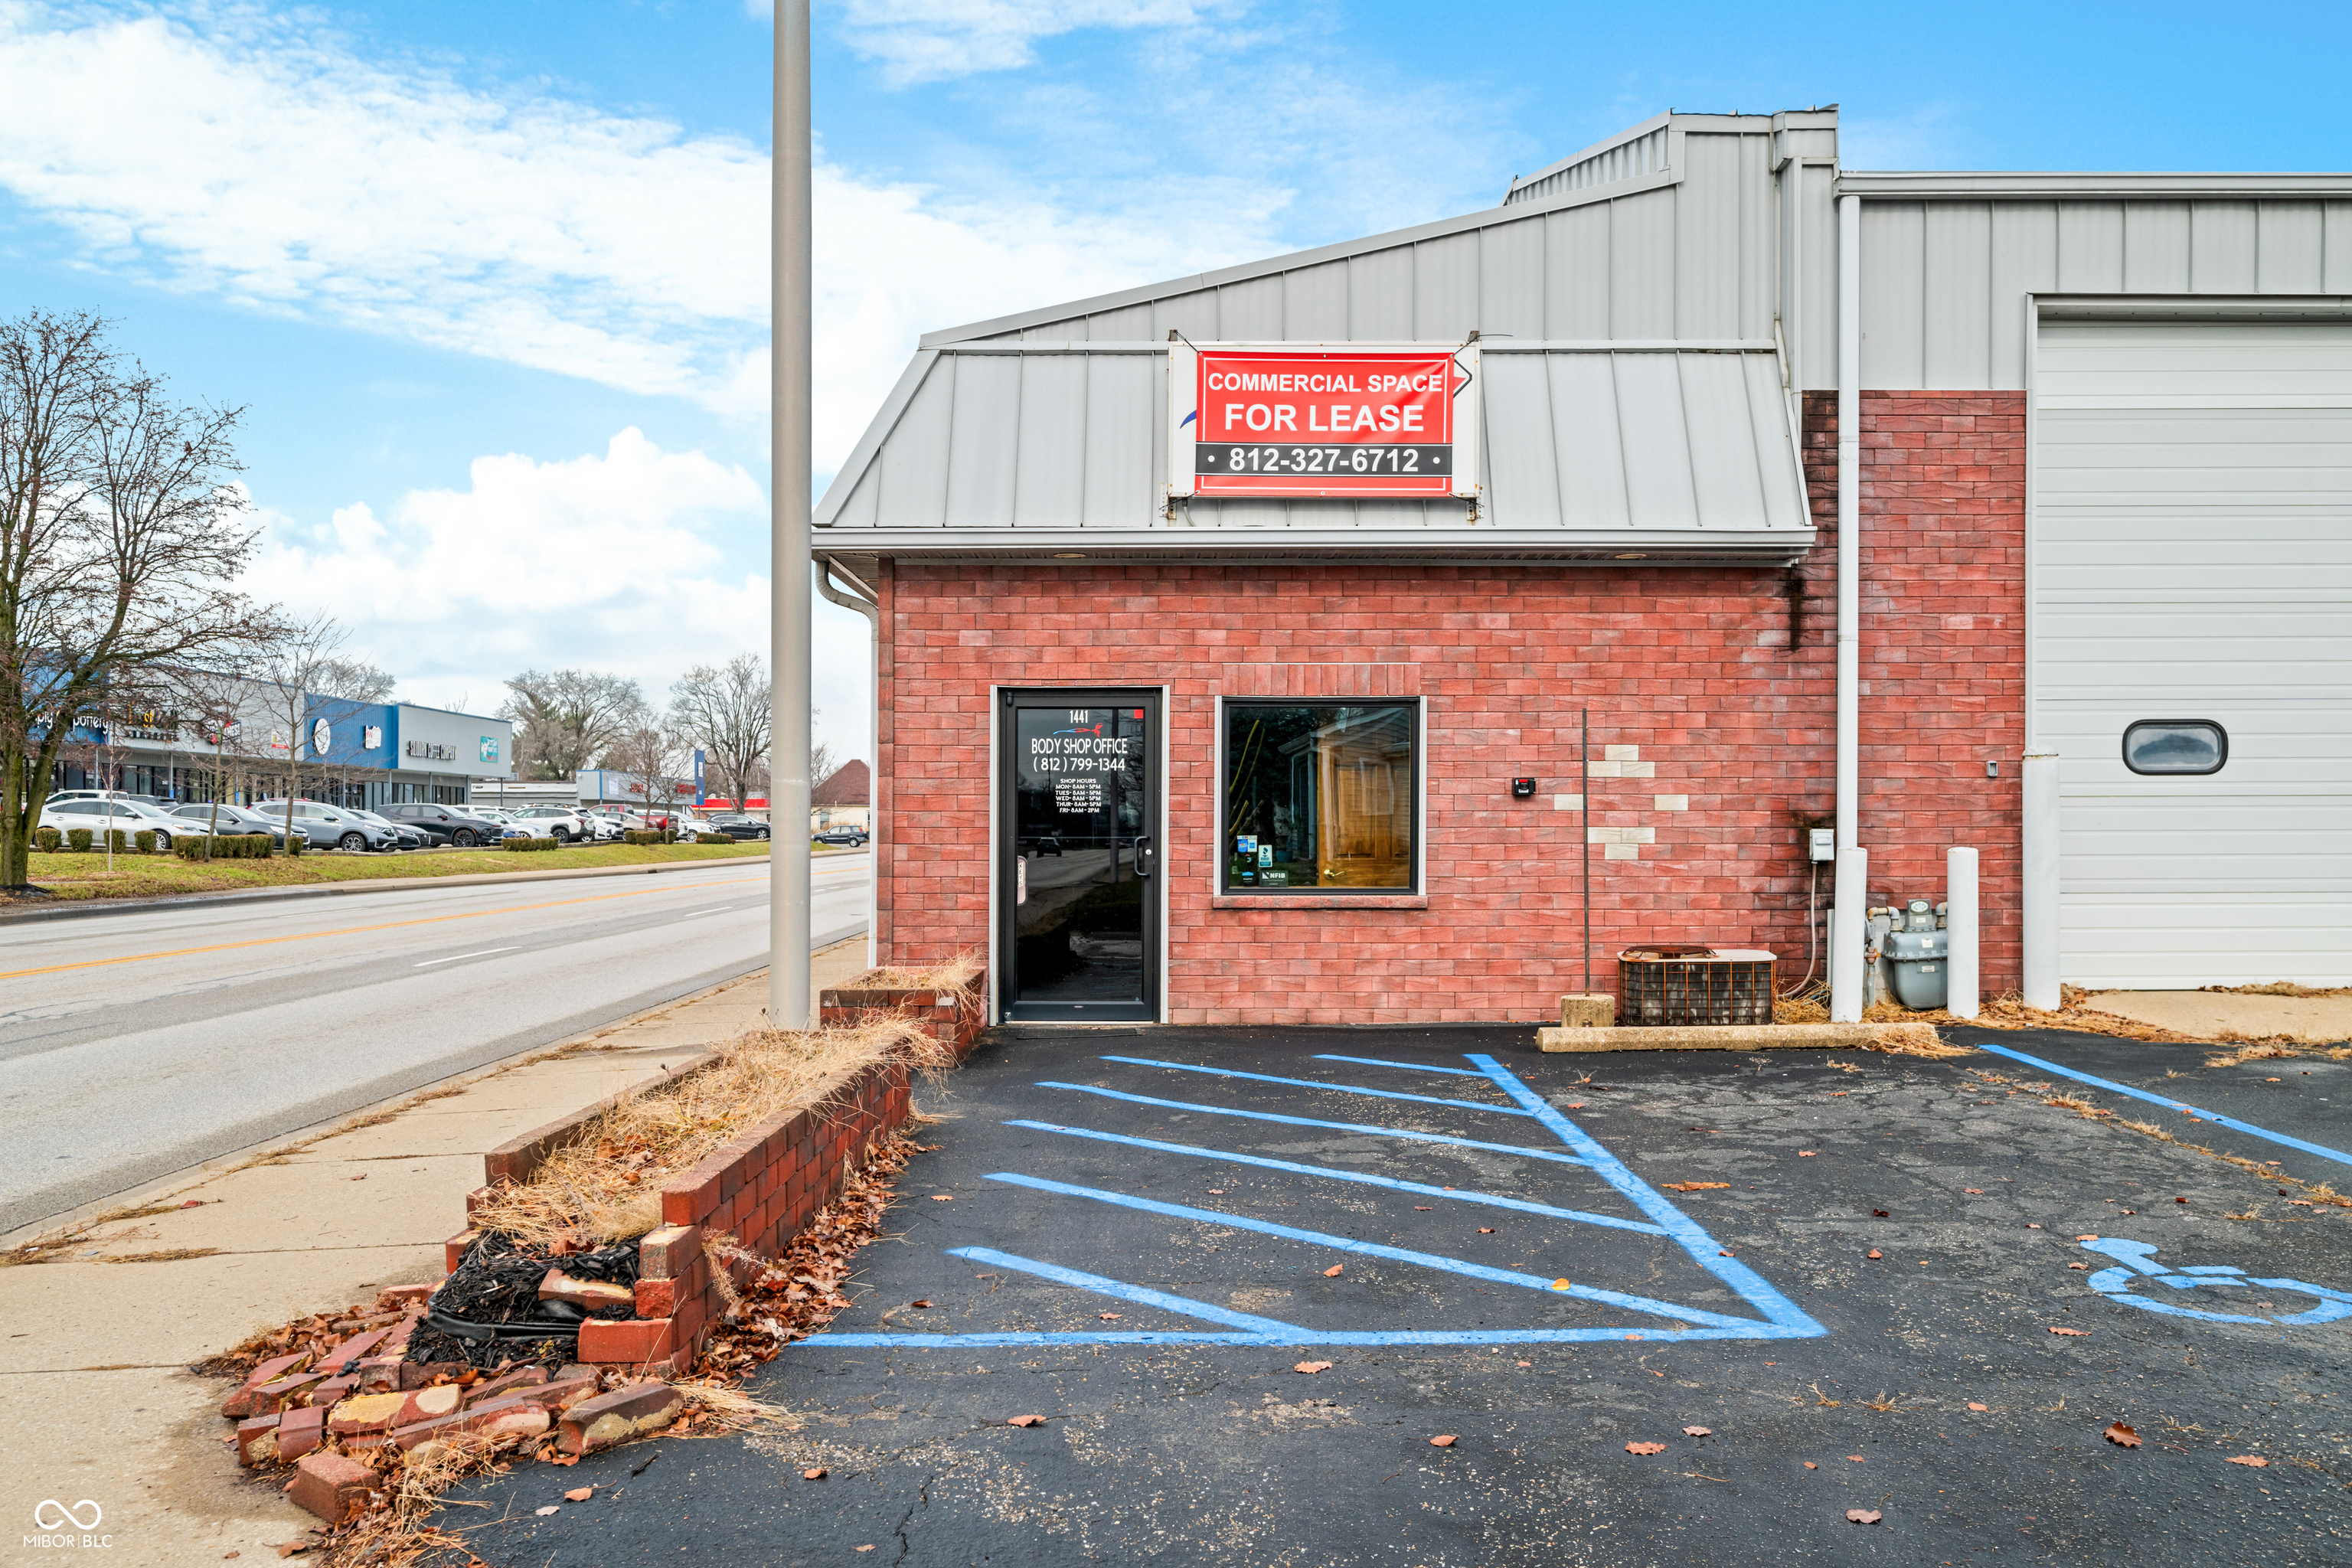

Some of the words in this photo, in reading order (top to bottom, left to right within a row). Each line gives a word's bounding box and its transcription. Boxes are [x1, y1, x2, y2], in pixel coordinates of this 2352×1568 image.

[1208, 373, 1361, 392] COMMERCIAL
[1367, 374, 1442, 392] SPACE
[1225, 403, 1297, 431] FOR
[1309, 405, 1424, 431] LEASE
[1230, 448, 1419, 472] 812-327-6712
[1070, 710, 1089, 724] 1441
[1031, 738, 1061, 754] BODY
[1063, 738, 1091, 754] SHOP
[1093, 738, 1128, 754] OFFICE
[1070, 757, 1125, 771] 799-1344
